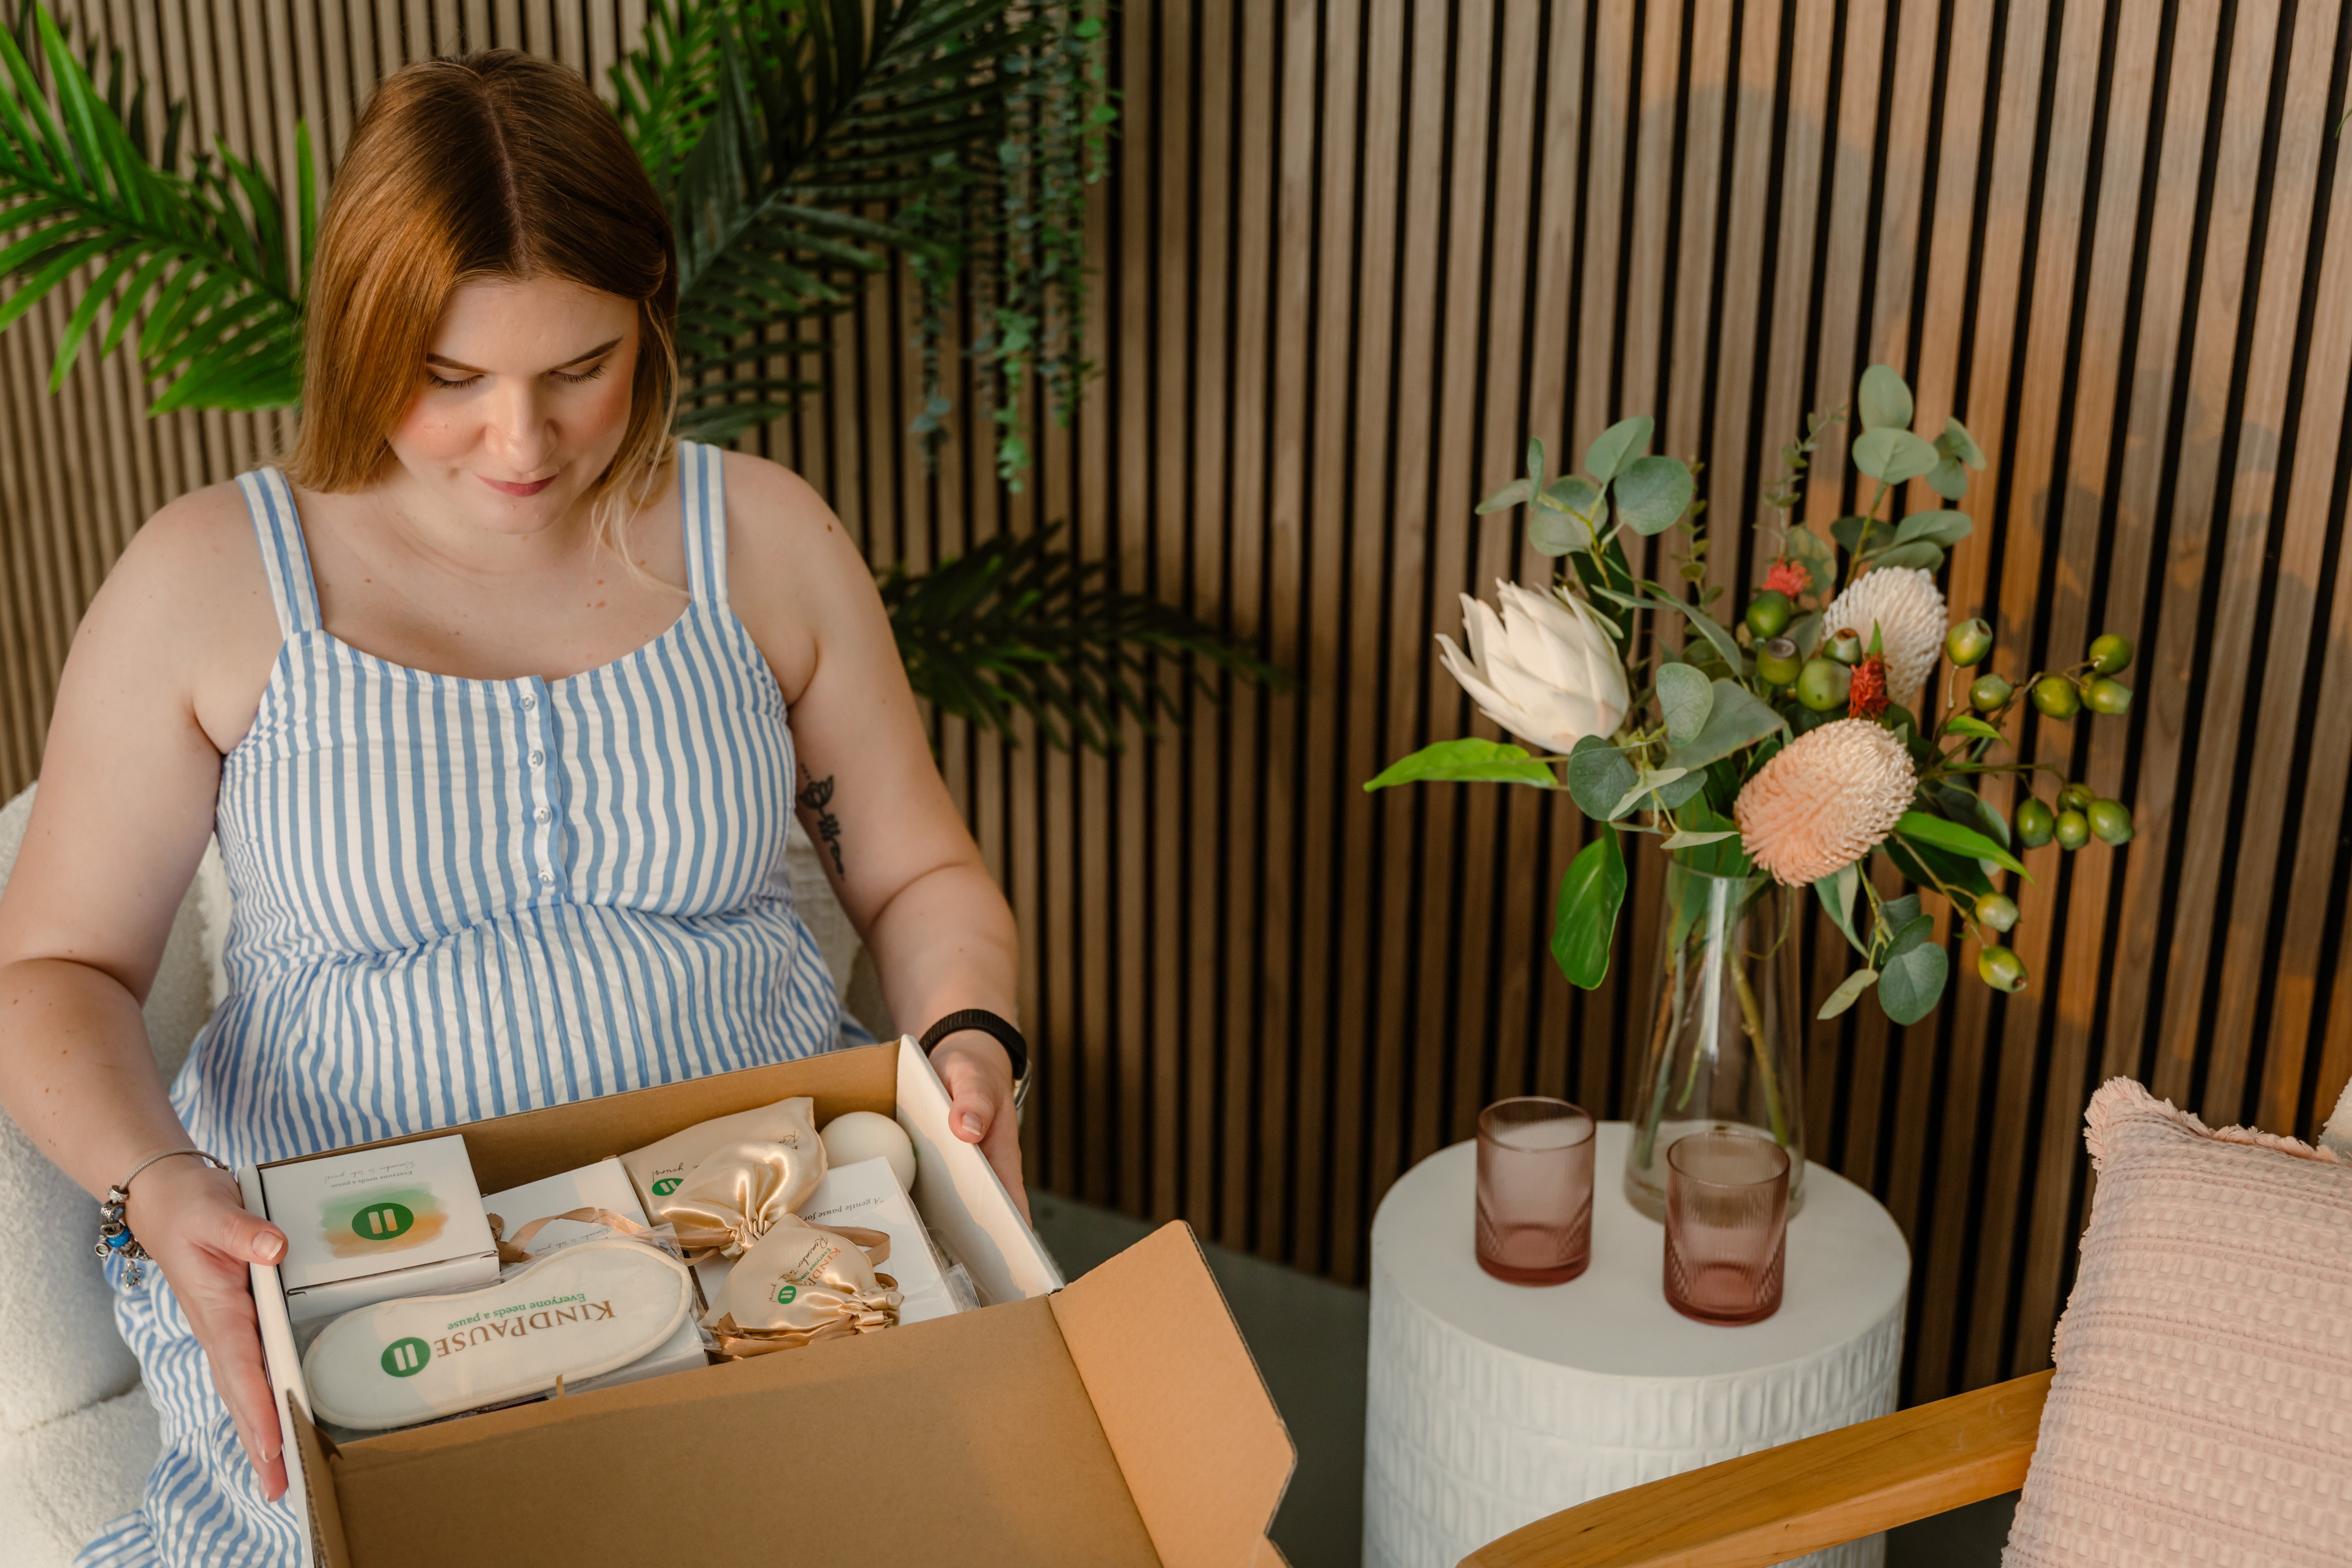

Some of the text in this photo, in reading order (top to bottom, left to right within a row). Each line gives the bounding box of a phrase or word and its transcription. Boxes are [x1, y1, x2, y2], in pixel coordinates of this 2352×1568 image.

[379, 1160, 415, 1171] Remember
[651, 1162, 683, 1182] yours!
[379, 1170, 412, 1179] Everyone
[817, 1205, 842, 1217] pause
[844, 1198, 870, 1210] gentle
[802, 1212, 816, 1221] for
[579, 1226, 610, 1240] Remember
[797, 1234, 827, 1267] Remember
[809, 1247, 831, 1270] Everyone
[529, 1292, 586, 1309] Everyone
[493, 1303, 525, 1317] needs
[446, 1312, 481, 1330] pause
